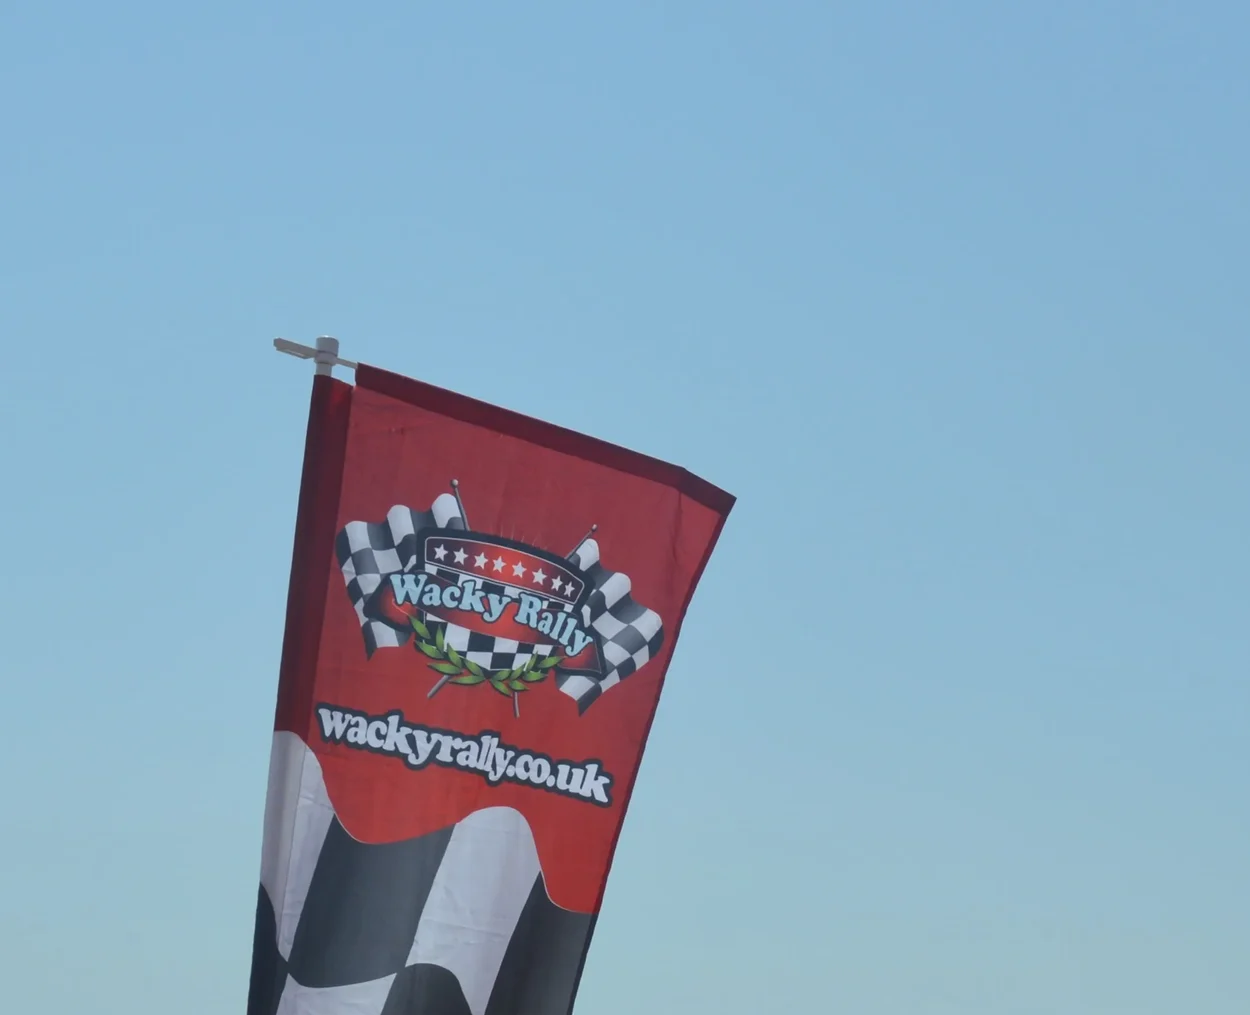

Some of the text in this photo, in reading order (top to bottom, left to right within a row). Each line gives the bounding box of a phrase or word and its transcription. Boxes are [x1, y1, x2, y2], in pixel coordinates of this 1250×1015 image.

[389, 572, 594, 656] Wacky Rally
[317, 706, 611, 804] wackyrally.co.uk
